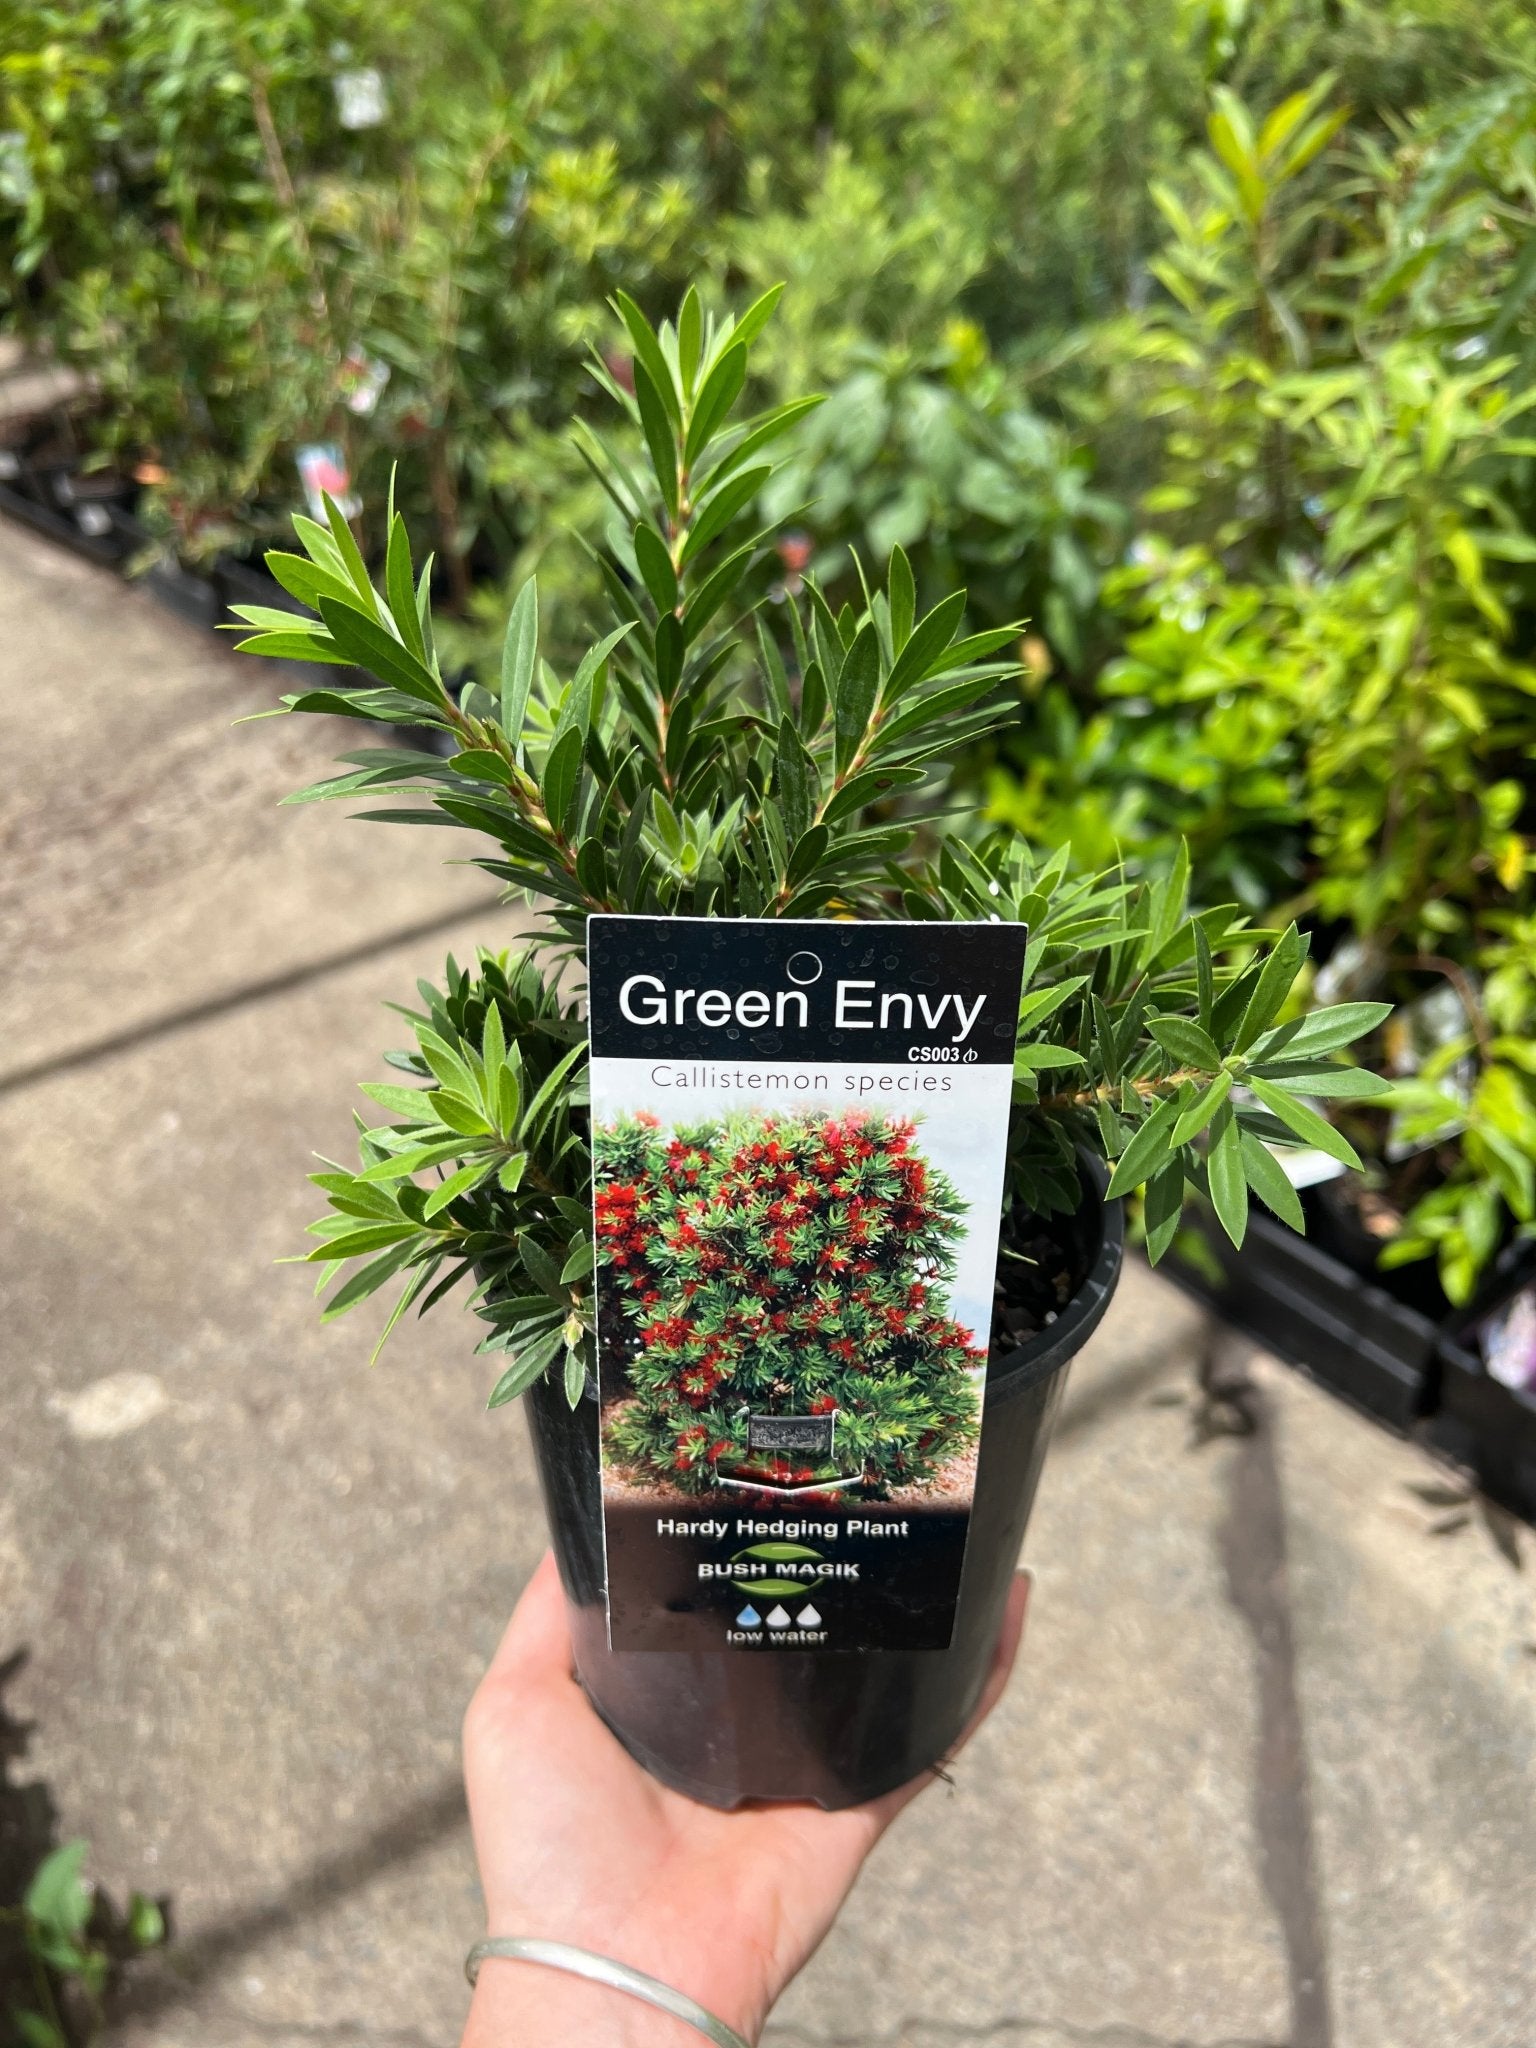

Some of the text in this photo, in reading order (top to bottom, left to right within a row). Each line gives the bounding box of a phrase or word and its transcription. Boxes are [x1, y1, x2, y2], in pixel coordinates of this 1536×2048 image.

[618, 974, 988, 1043] Green Envy
[907, 1046, 960, 1063] CS003
[650, 1065, 953, 1096] Callistemon species
[656, 1518, 910, 1540] Hardy Hedging Plant
[697, 1562, 860, 1579] BUSH MAGIK
[725, 1628, 829, 1645] low water
